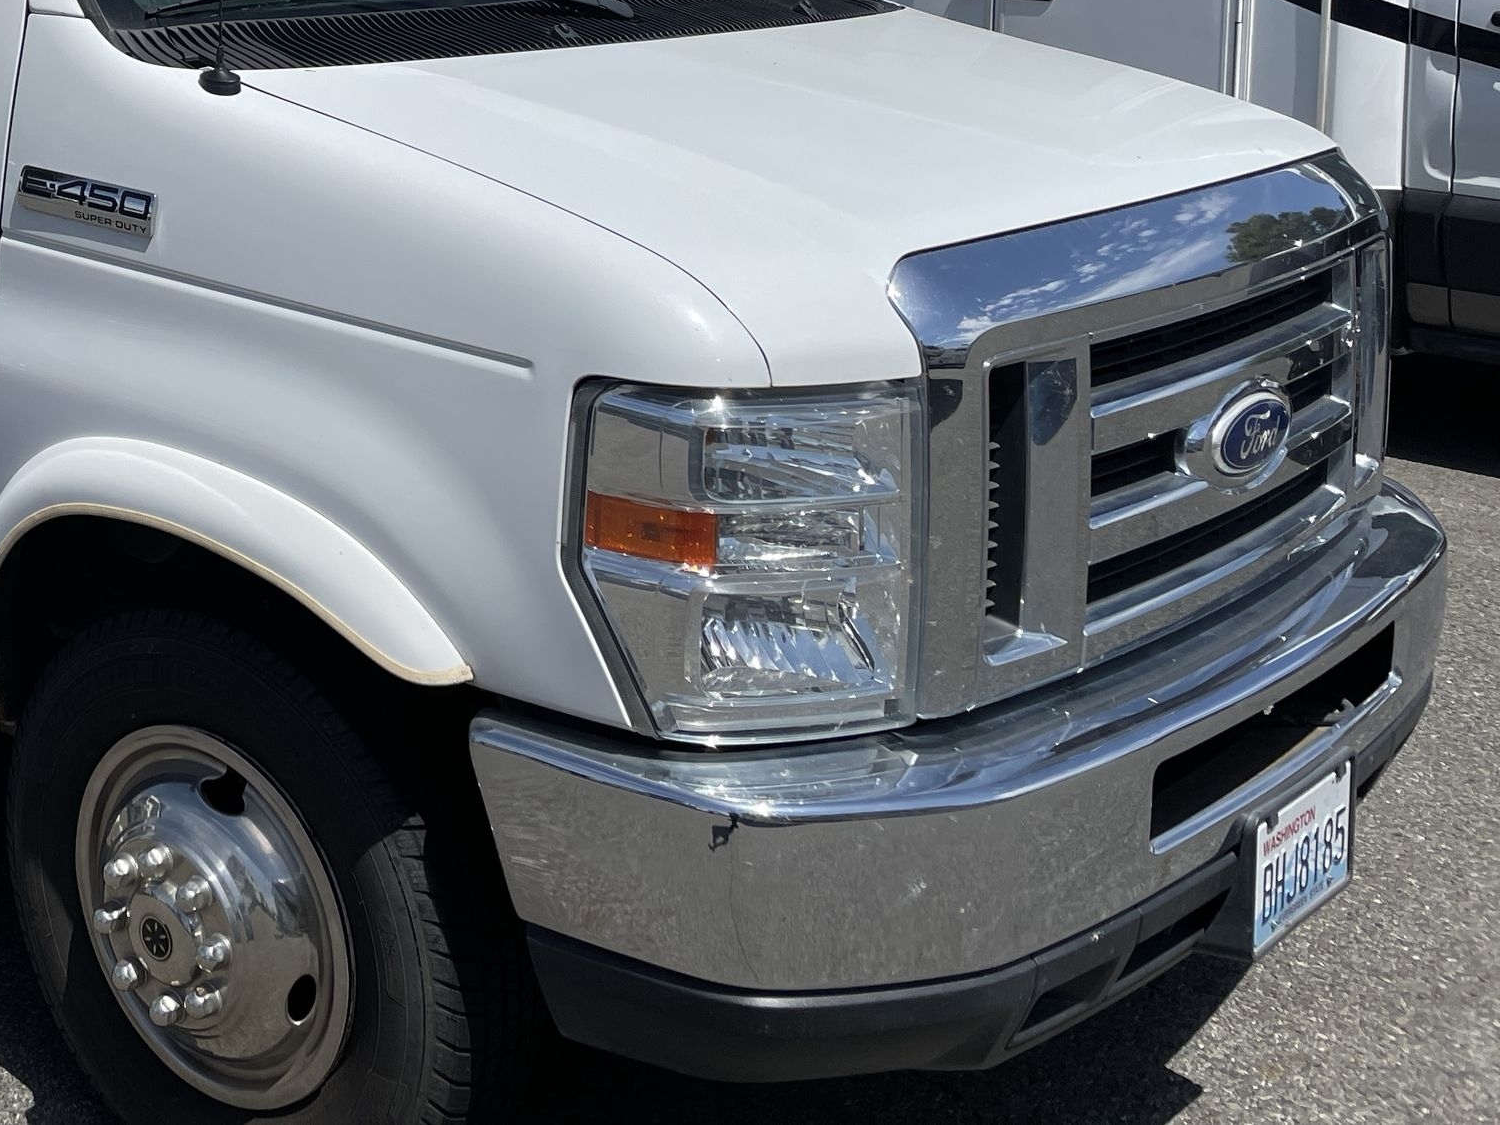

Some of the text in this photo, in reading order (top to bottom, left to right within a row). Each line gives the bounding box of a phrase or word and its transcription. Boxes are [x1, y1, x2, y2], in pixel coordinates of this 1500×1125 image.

[74, 210, 147, 234] SUPER DUTY
[1240, 409, 1281, 460] Ford
[1263, 805, 1316, 856] WASHINGTON
[1261, 806, 1346, 926] BHJ8185
